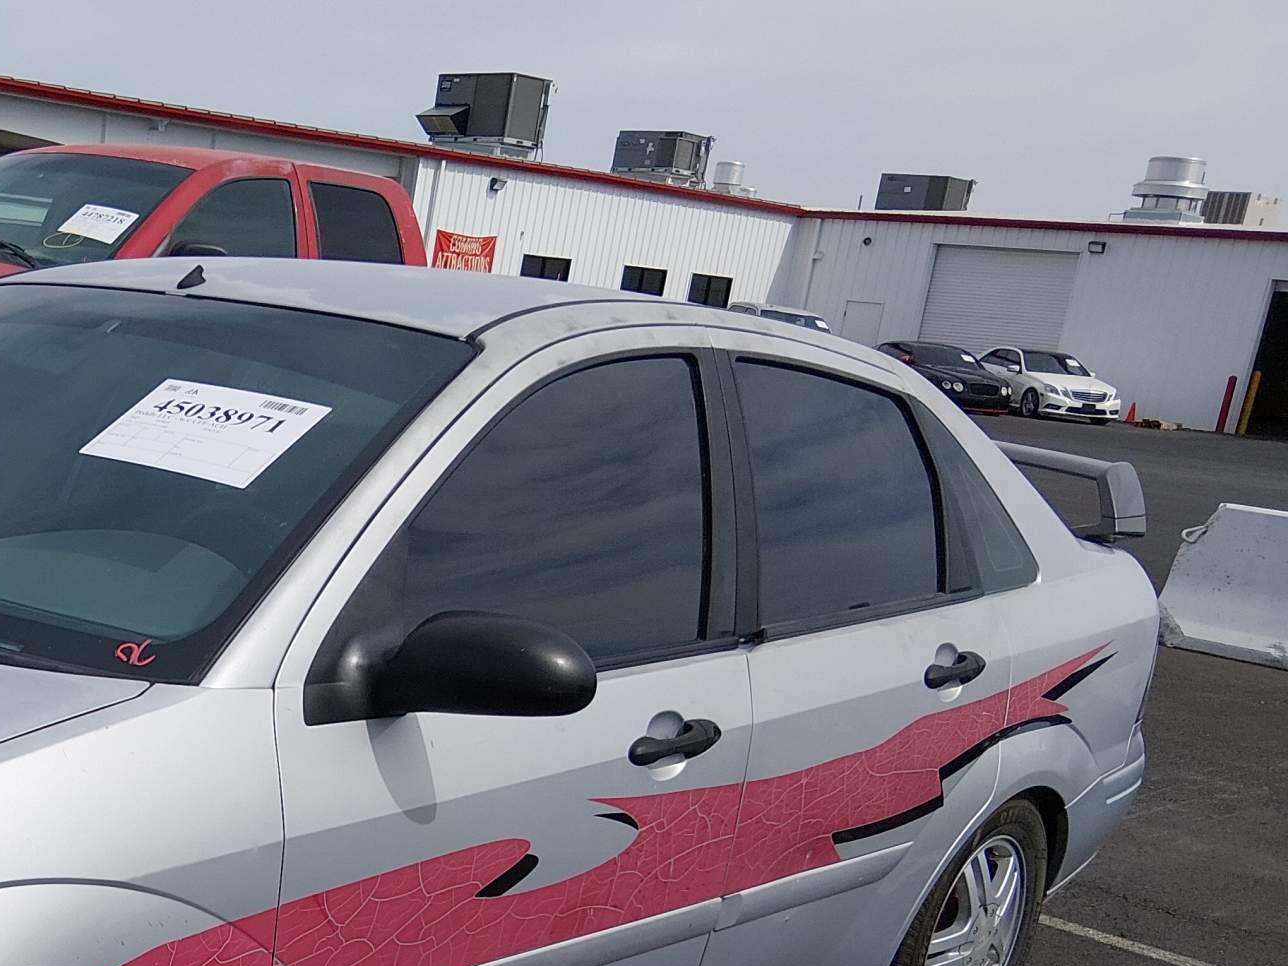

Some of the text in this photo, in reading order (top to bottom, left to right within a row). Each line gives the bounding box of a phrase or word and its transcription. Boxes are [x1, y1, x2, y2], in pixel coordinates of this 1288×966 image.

[450, 235, 483, 254] COMING
[435, 252, 490, 272] ATTRACTIONS
[152, 398, 288, 434] 45038971
